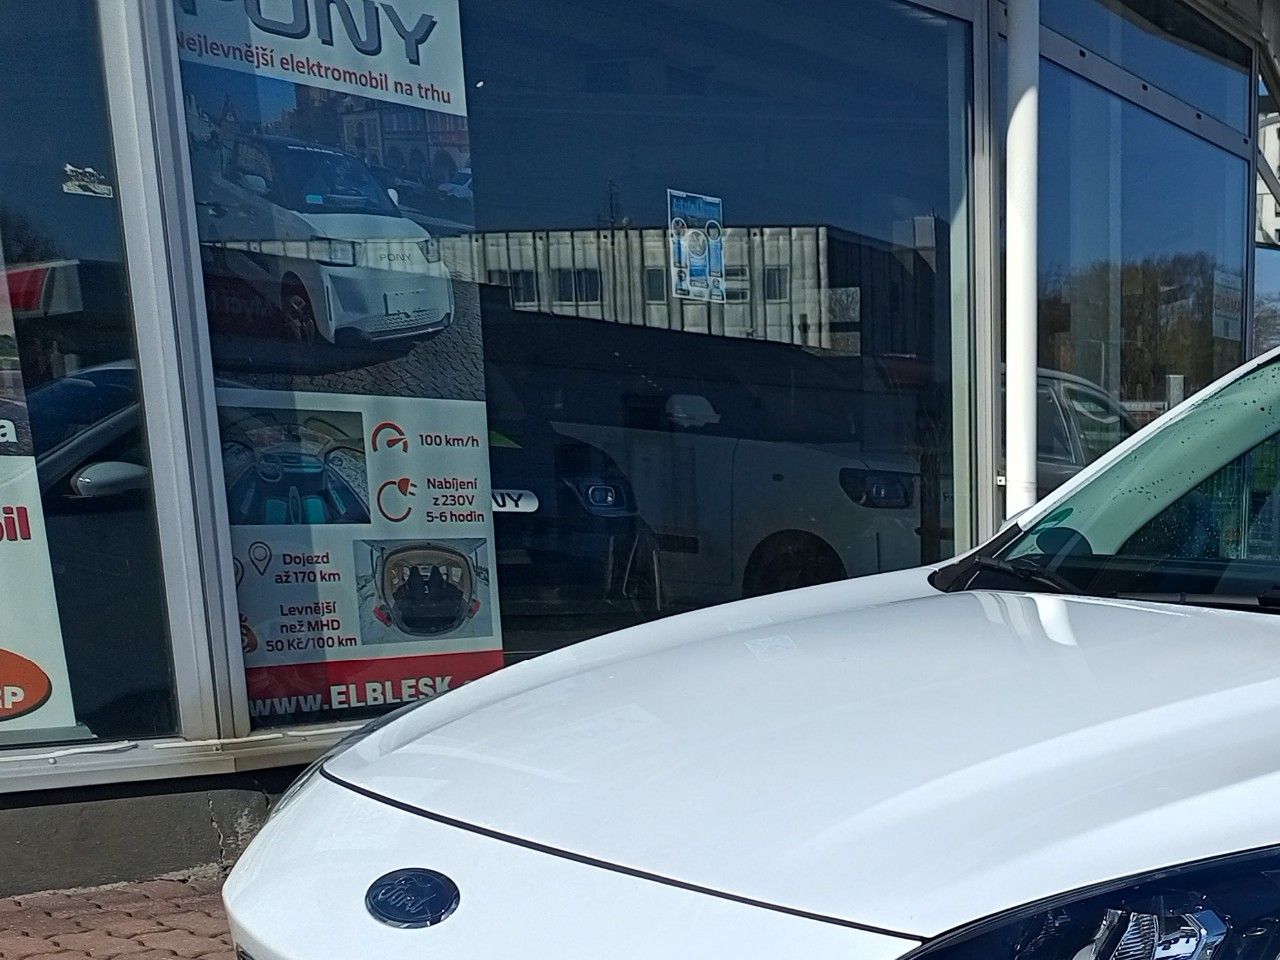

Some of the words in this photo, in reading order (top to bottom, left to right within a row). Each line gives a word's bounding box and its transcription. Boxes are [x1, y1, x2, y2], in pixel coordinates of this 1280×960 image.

[179, 0, 437, 66] ONY
[280, 54, 389, 92] elektromobil
[394, 80, 413, 96] na
[416, 83, 451, 104] trhu
[419, 434, 442, 446] 100
[445, 434, 479, 447] km/h
[427, 478, 478, 491] Nabíjení
[433, 497, 440, 506] z
[442, 495, 475, 506] 230V
[0, 506, 31, 541] il
[426, 512, 448, 523] 5-6
[450, 511, 484, 523] hodin
[282, 553, 330, 567] Dojezd
[275, 571, 291, 584] až
[293, 571, 317, 583] 170
[320, 570, 341, 582] km
[280, 601, 336, 616] Levnější
[280, 621, 305, 634] než
[307, 620, 341, 632] MHD
[266, 640, 284, 652] 50
[288, 637, 335, 650] Kč/100
[338, 635, 357, 647] km
[249, 676, 471, 717] www.ELBLESK
